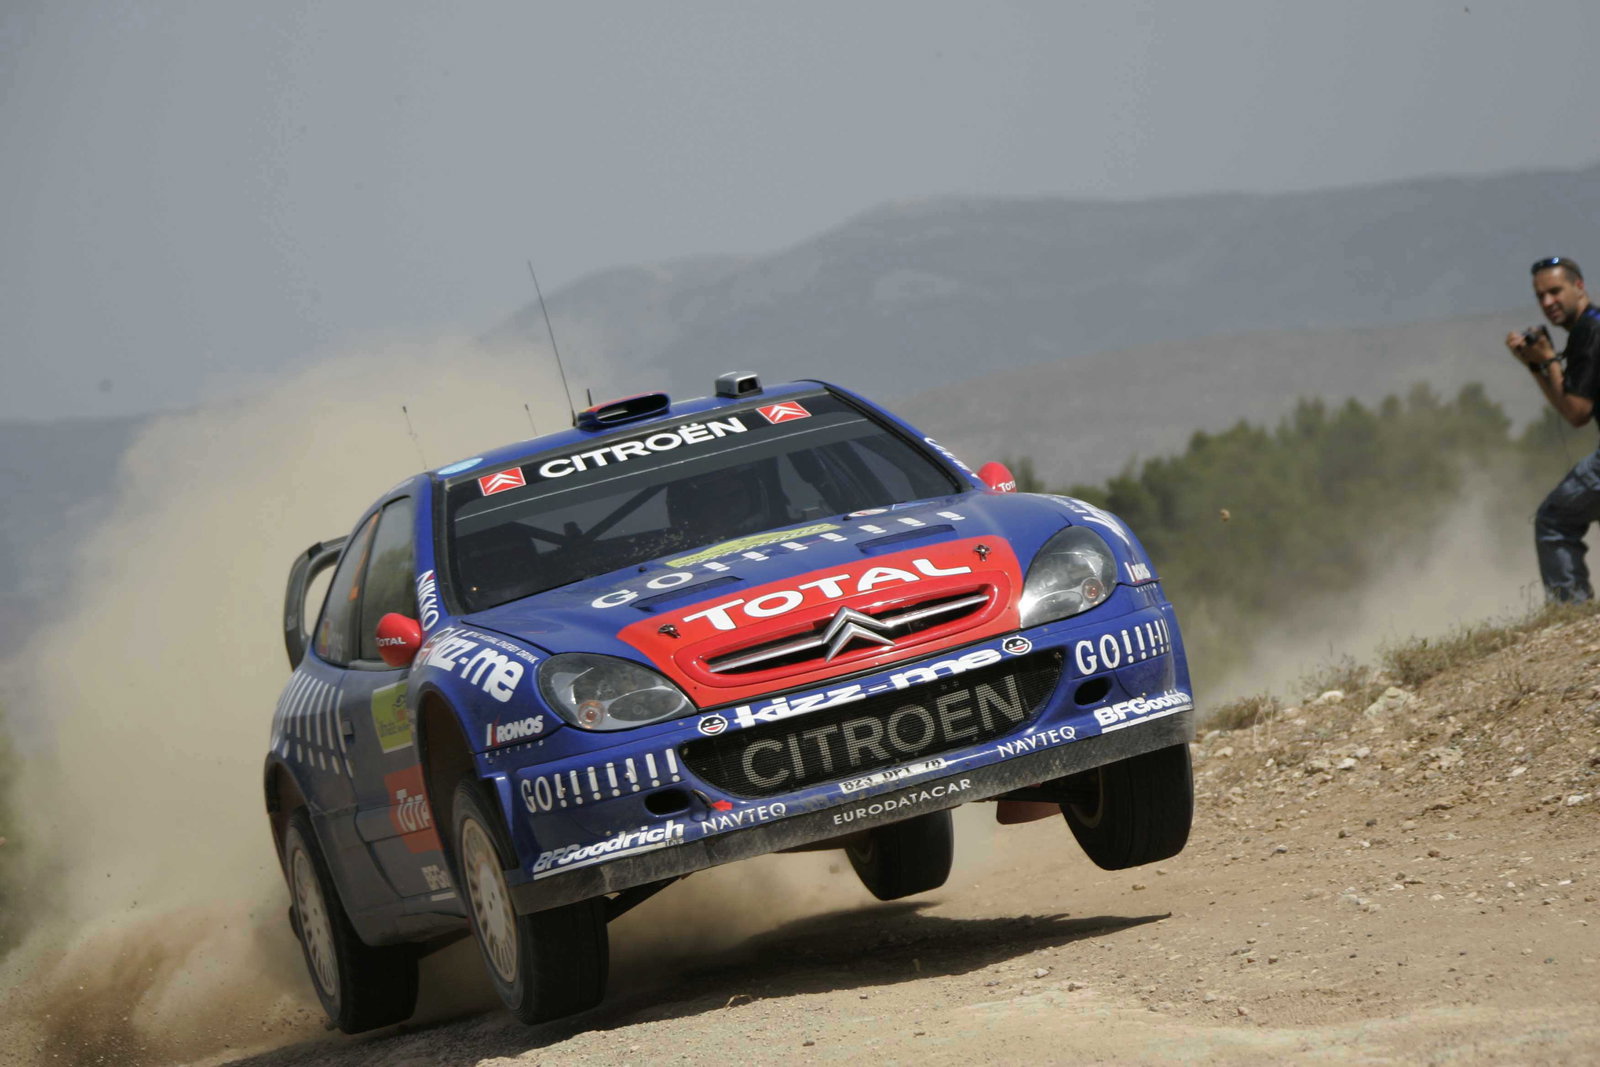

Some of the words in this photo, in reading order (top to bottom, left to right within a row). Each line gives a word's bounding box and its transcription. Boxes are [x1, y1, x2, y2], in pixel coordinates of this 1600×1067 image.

[539, 416, 748, 479] CITROËN
[416, 569, 439, 632] NIKKO
[682, 558, 973, 632] TOTAL
[734, 648, 1002, 728] kizz-me
[997, 725, 1076, 758] NAVTEQ
[701, 802, 786, 834] NAVTEQ
[832, 778, 972, 826] EURODATACAR
[533, 819, 686, 873] BFGoodrich
